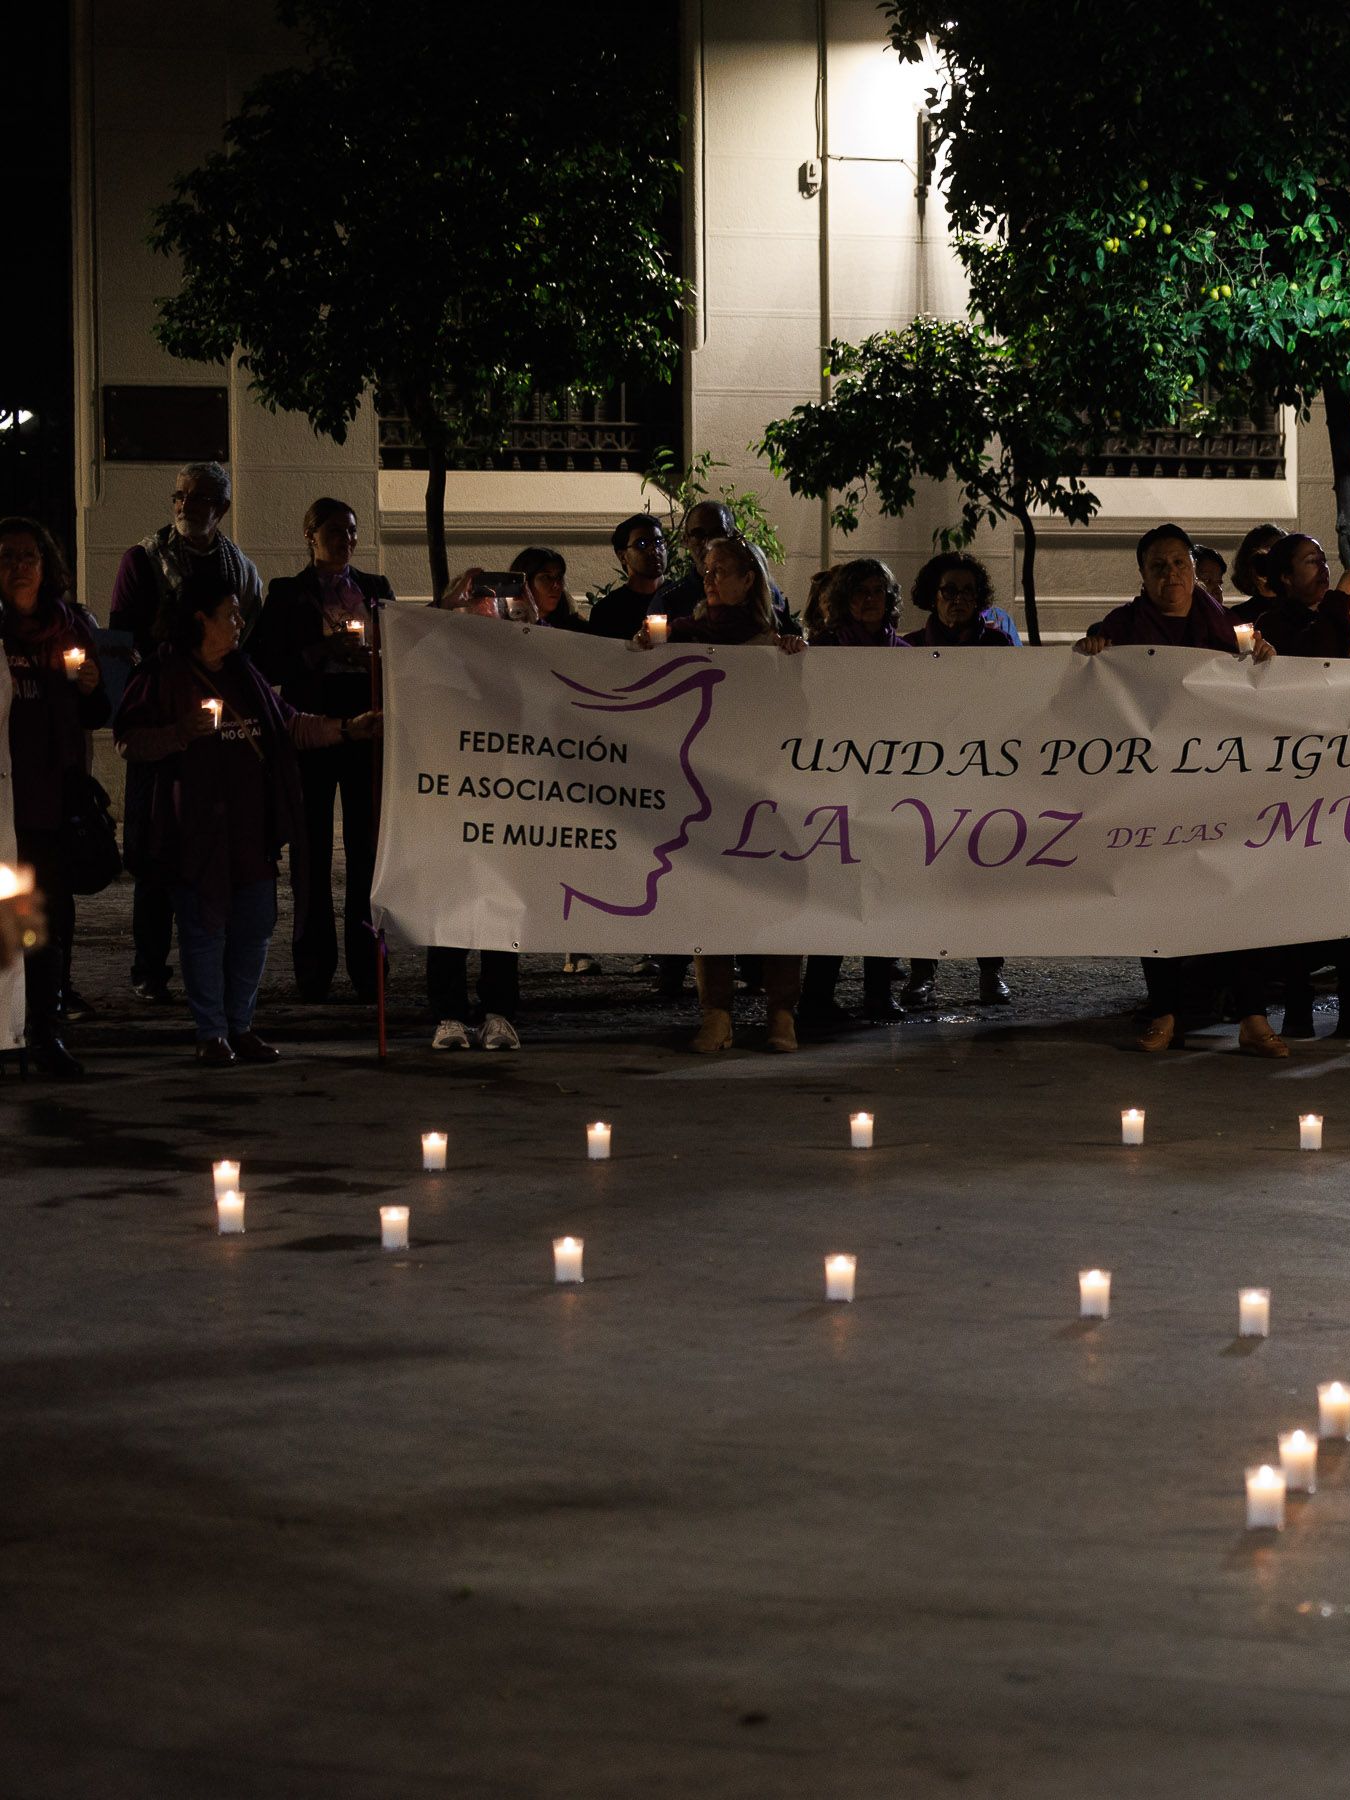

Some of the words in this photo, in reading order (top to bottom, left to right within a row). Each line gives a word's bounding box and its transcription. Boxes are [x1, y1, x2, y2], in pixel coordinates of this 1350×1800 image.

[459, 730, 628, 763] FEDERACIÓN
[782, 738, 1020, 776] UNIDAS
[1041, 738, 1158, 775] POR
[1171, 737, 1251, 773] LA
[418, 773, 448, 795] DE
[458, 776, 666, 810] ASOCIACIONES
[463, 822, 494, 844] DE
[502, 824, 617, 850] MUJERES
[722, 800, 860, 863] LA
[891, 799, 1083, 867] VOZ
[1107, 827, 1157, 848] DE
[1163, 822, 1226, 846] LAS
